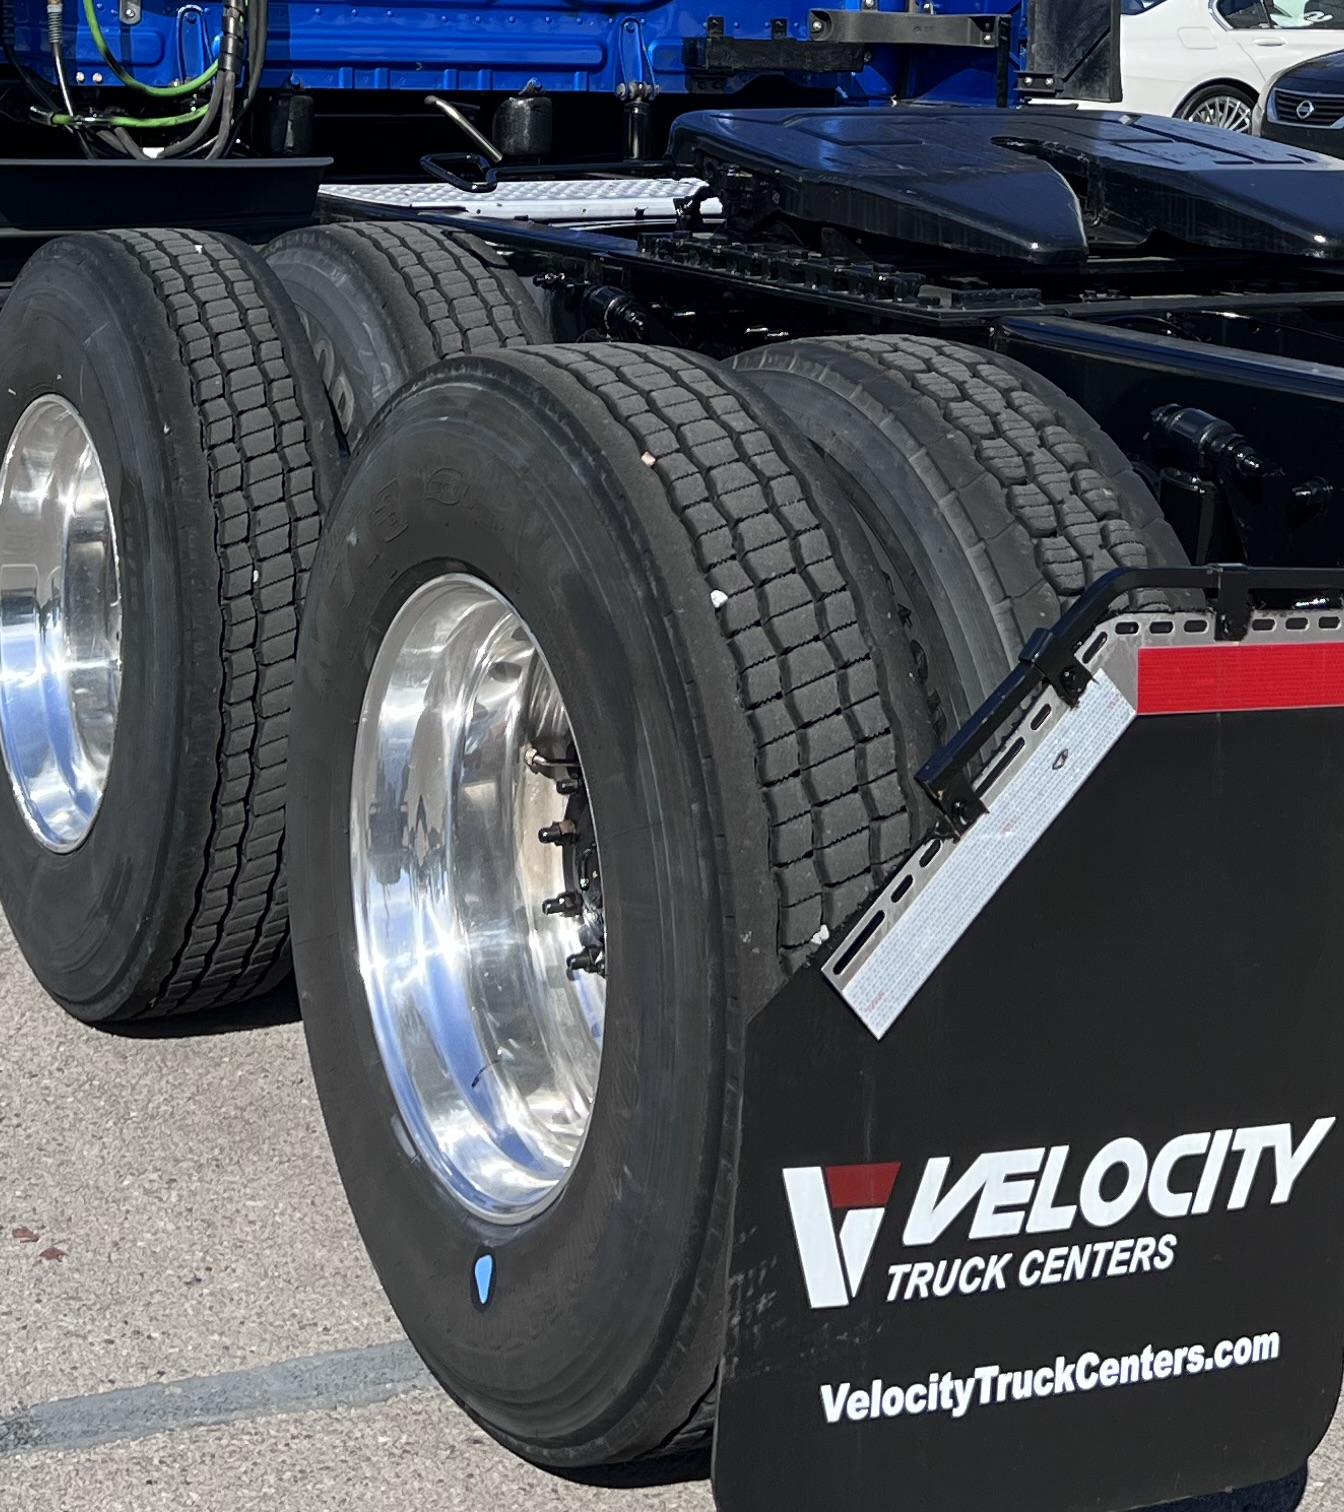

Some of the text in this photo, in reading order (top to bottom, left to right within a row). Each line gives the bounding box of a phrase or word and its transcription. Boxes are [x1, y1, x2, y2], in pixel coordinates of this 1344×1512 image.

[902, 1116, 1337, 1246] VELOCITY
[886, 1233, 1177, 1302] TRUCK CENTERS
[820, 1331, 1280, 1423] VelocityTruckCenters.com
